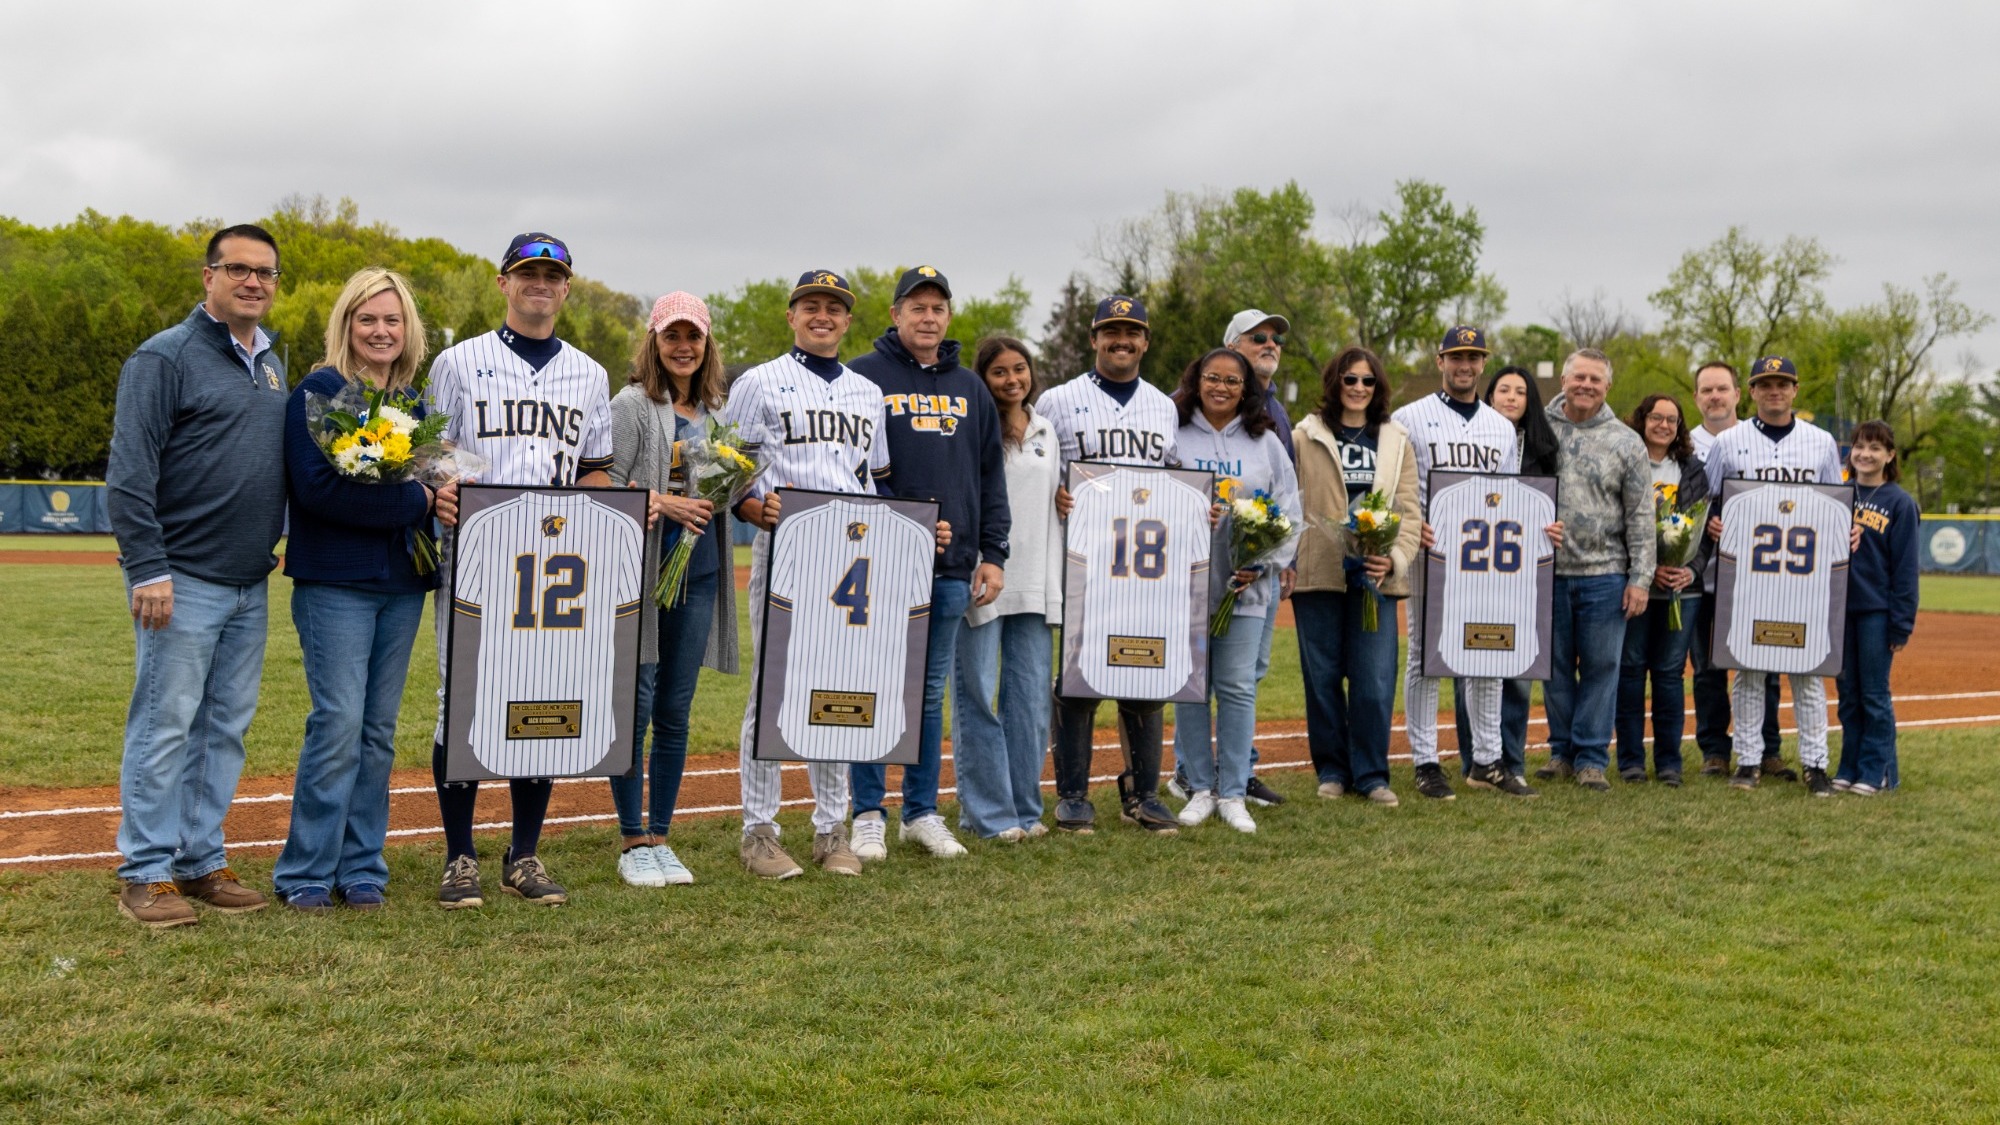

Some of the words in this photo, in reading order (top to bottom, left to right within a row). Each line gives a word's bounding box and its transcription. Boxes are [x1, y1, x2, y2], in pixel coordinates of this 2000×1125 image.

[475, 399, 584, 448] LIONS
[883, 393, 968, 418] TCNJ
[780, 409, 874, 453] LIONS
[1075, 428, 1165, 462] LIONS
[1194, 458, 1241, 476] TCNJ
[1428, 442, 1502, 473] LIONS
[1111, 516, 1168, 580] 18
[1460, 518, 1523, 573] 26
[1751, 523, 1818, 576] 29
[511, 552, 588, 630] 12
[829, 555, 871, 627] 4
